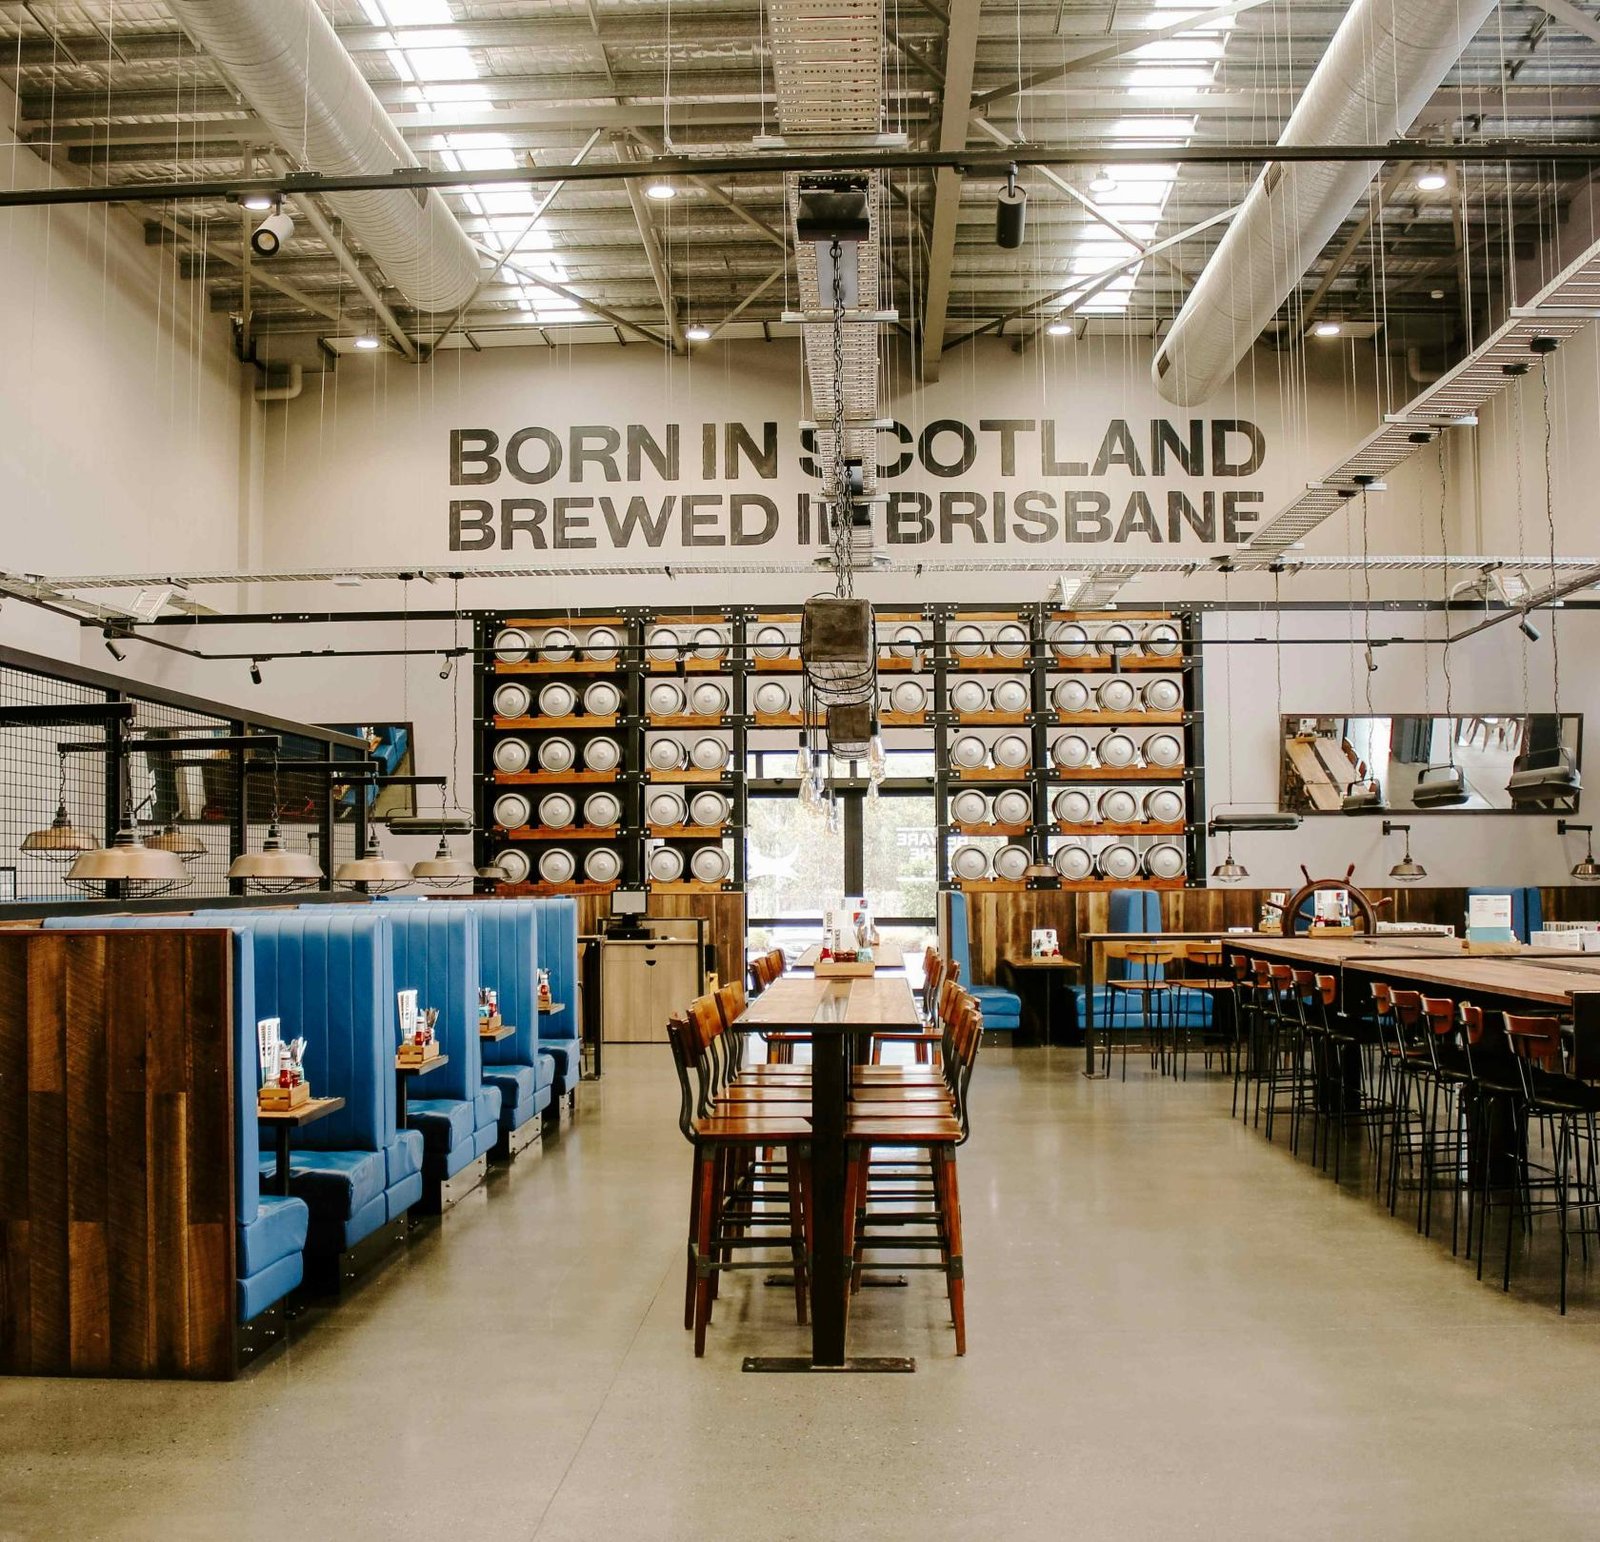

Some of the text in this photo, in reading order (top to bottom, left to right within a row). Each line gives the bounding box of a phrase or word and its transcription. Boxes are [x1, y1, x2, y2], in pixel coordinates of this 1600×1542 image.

[450, 424, 679, 486] BORN
[703, 422, 777, 480] IN
[449, 494, 779, 551] BREWED
[887, 491, 1264, 545] BRISBANE
